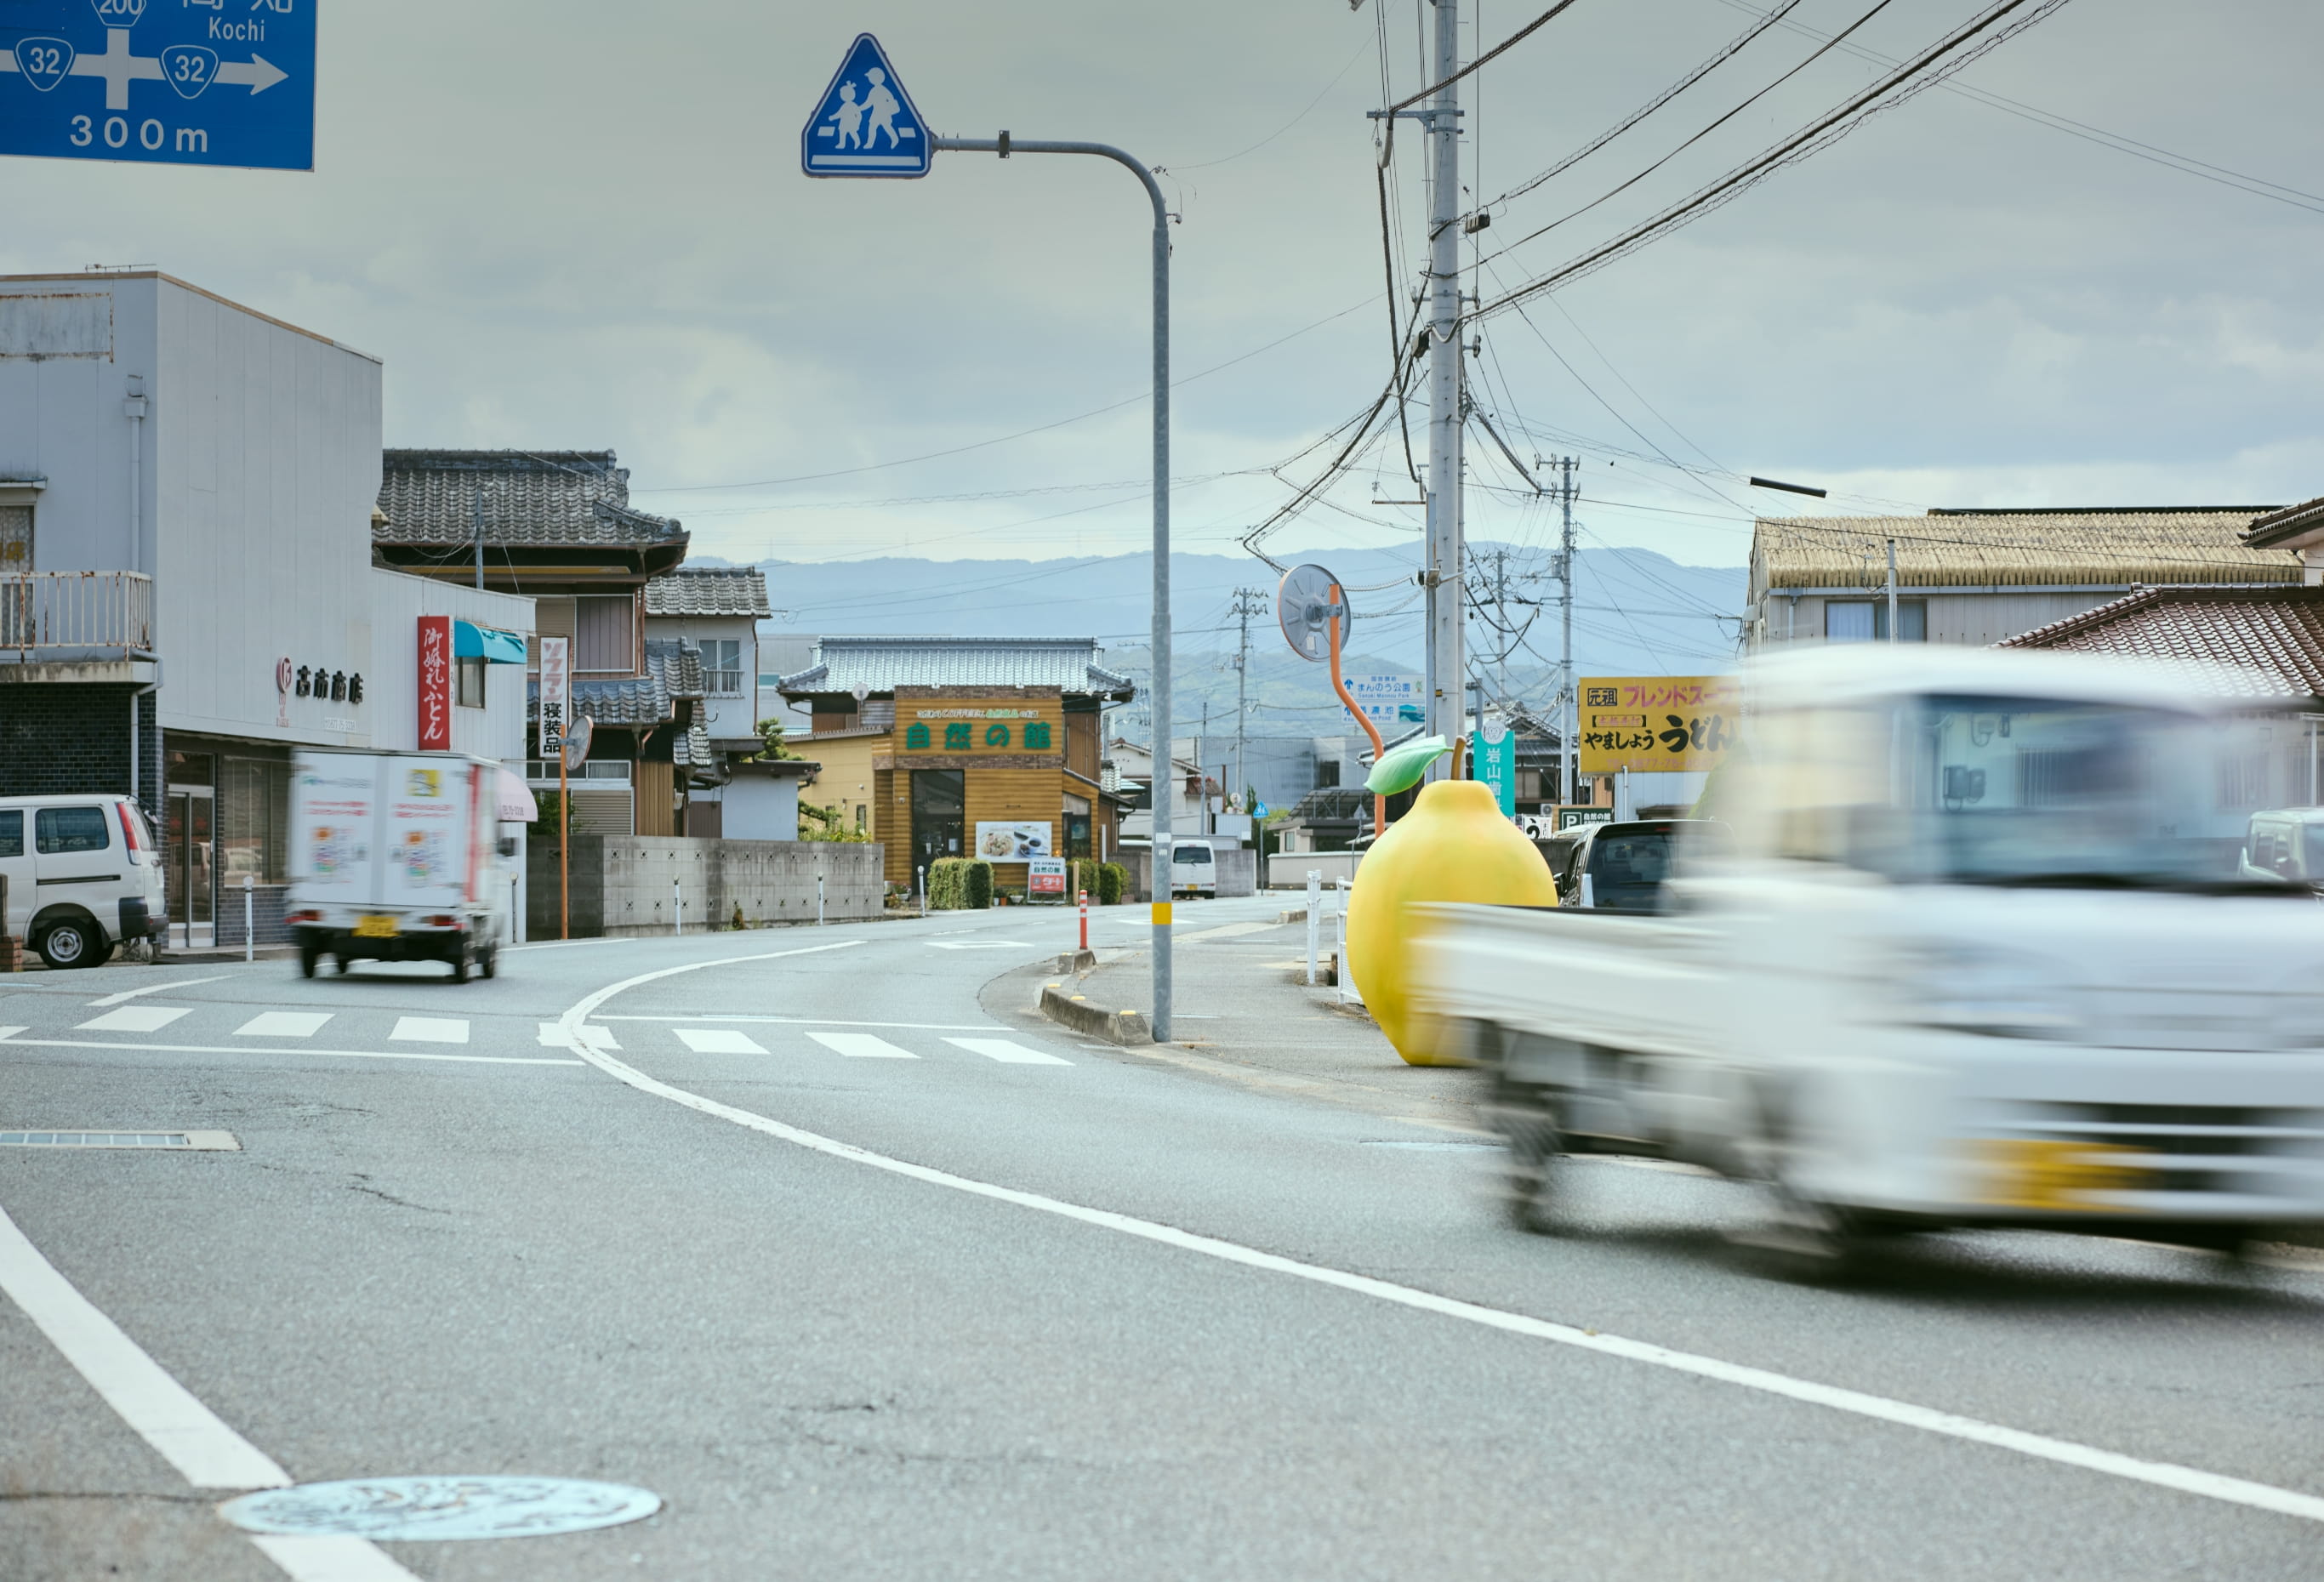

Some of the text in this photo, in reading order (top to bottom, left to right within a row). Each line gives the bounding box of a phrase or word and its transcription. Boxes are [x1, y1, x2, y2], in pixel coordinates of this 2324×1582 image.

[209, 16, 265, 42] Kochi
[30, 48, 205, 83] 32 32
[424, 627, 446, 741] 御婚礼ふとん
[1358, 682, 1410, 692] まんのう公園
[1589, 689, 1616, 705] 元祖
[906, 721, 1051, 750] 自然の館
[1584, 714, 1738, 753] やましょう うどん
[1485, 748, 1502, 808] 岩山歯
